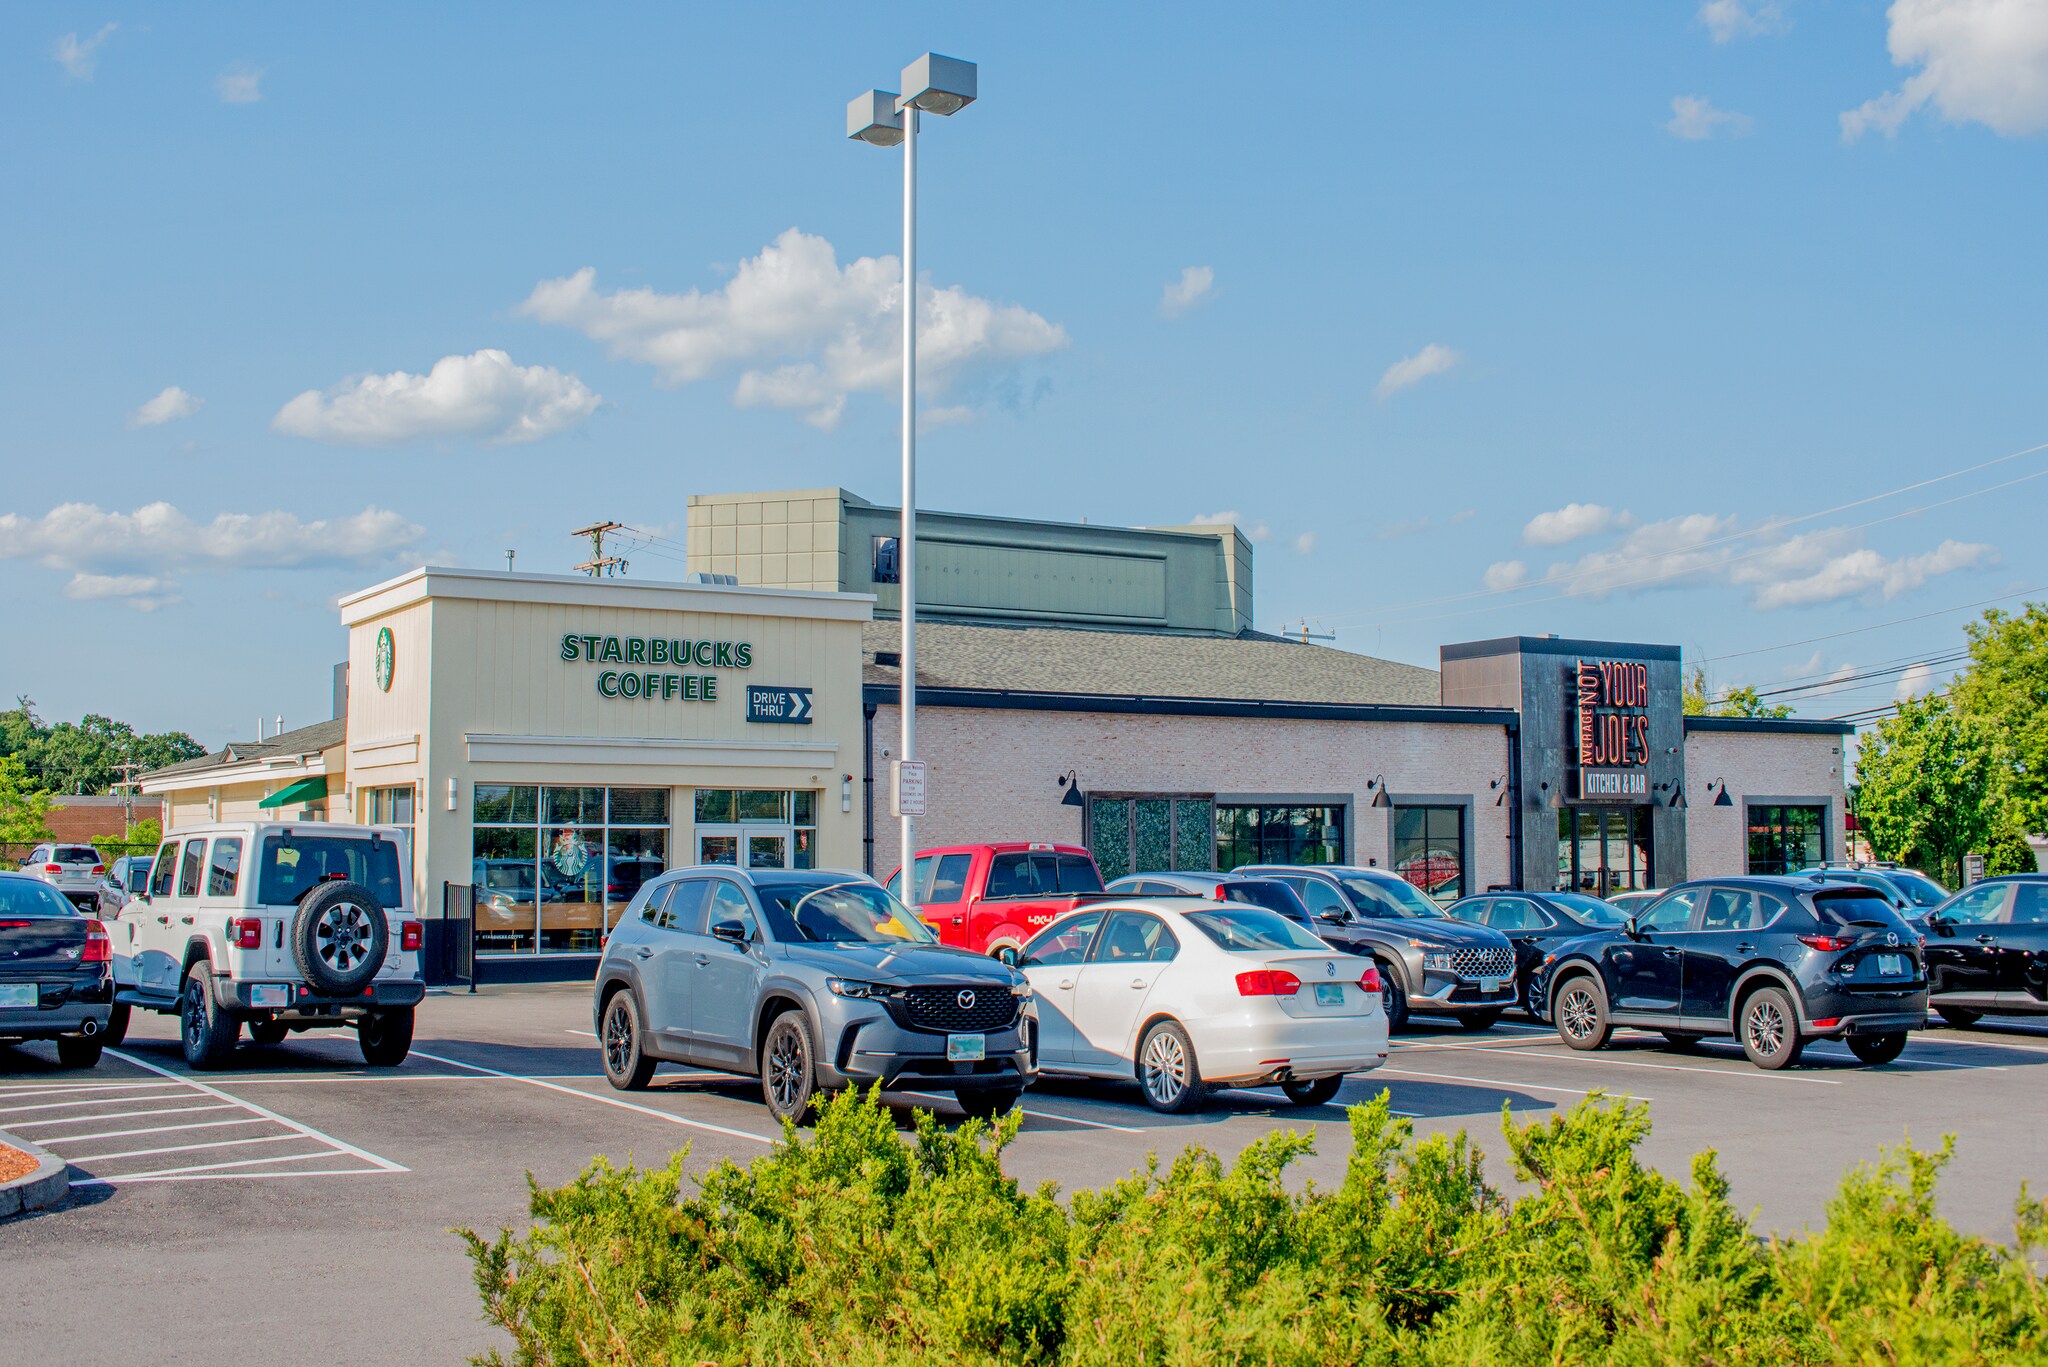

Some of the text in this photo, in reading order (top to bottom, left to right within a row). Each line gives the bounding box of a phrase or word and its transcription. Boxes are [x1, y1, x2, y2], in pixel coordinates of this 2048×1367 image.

[561, 633, 752, 668] STARBUCKS
[598, 670, 718, 701] COFFEE
[753, 692, 786, 705] DRIVE
[1578, 659, 1649, 707] NOT YOUR
[753, 704, 784, 716] THRU
[1582, 705, 1650, 766] AVERAGE JOE'S
[1587, 773, 1646, 794] KITCHEN & BAR
